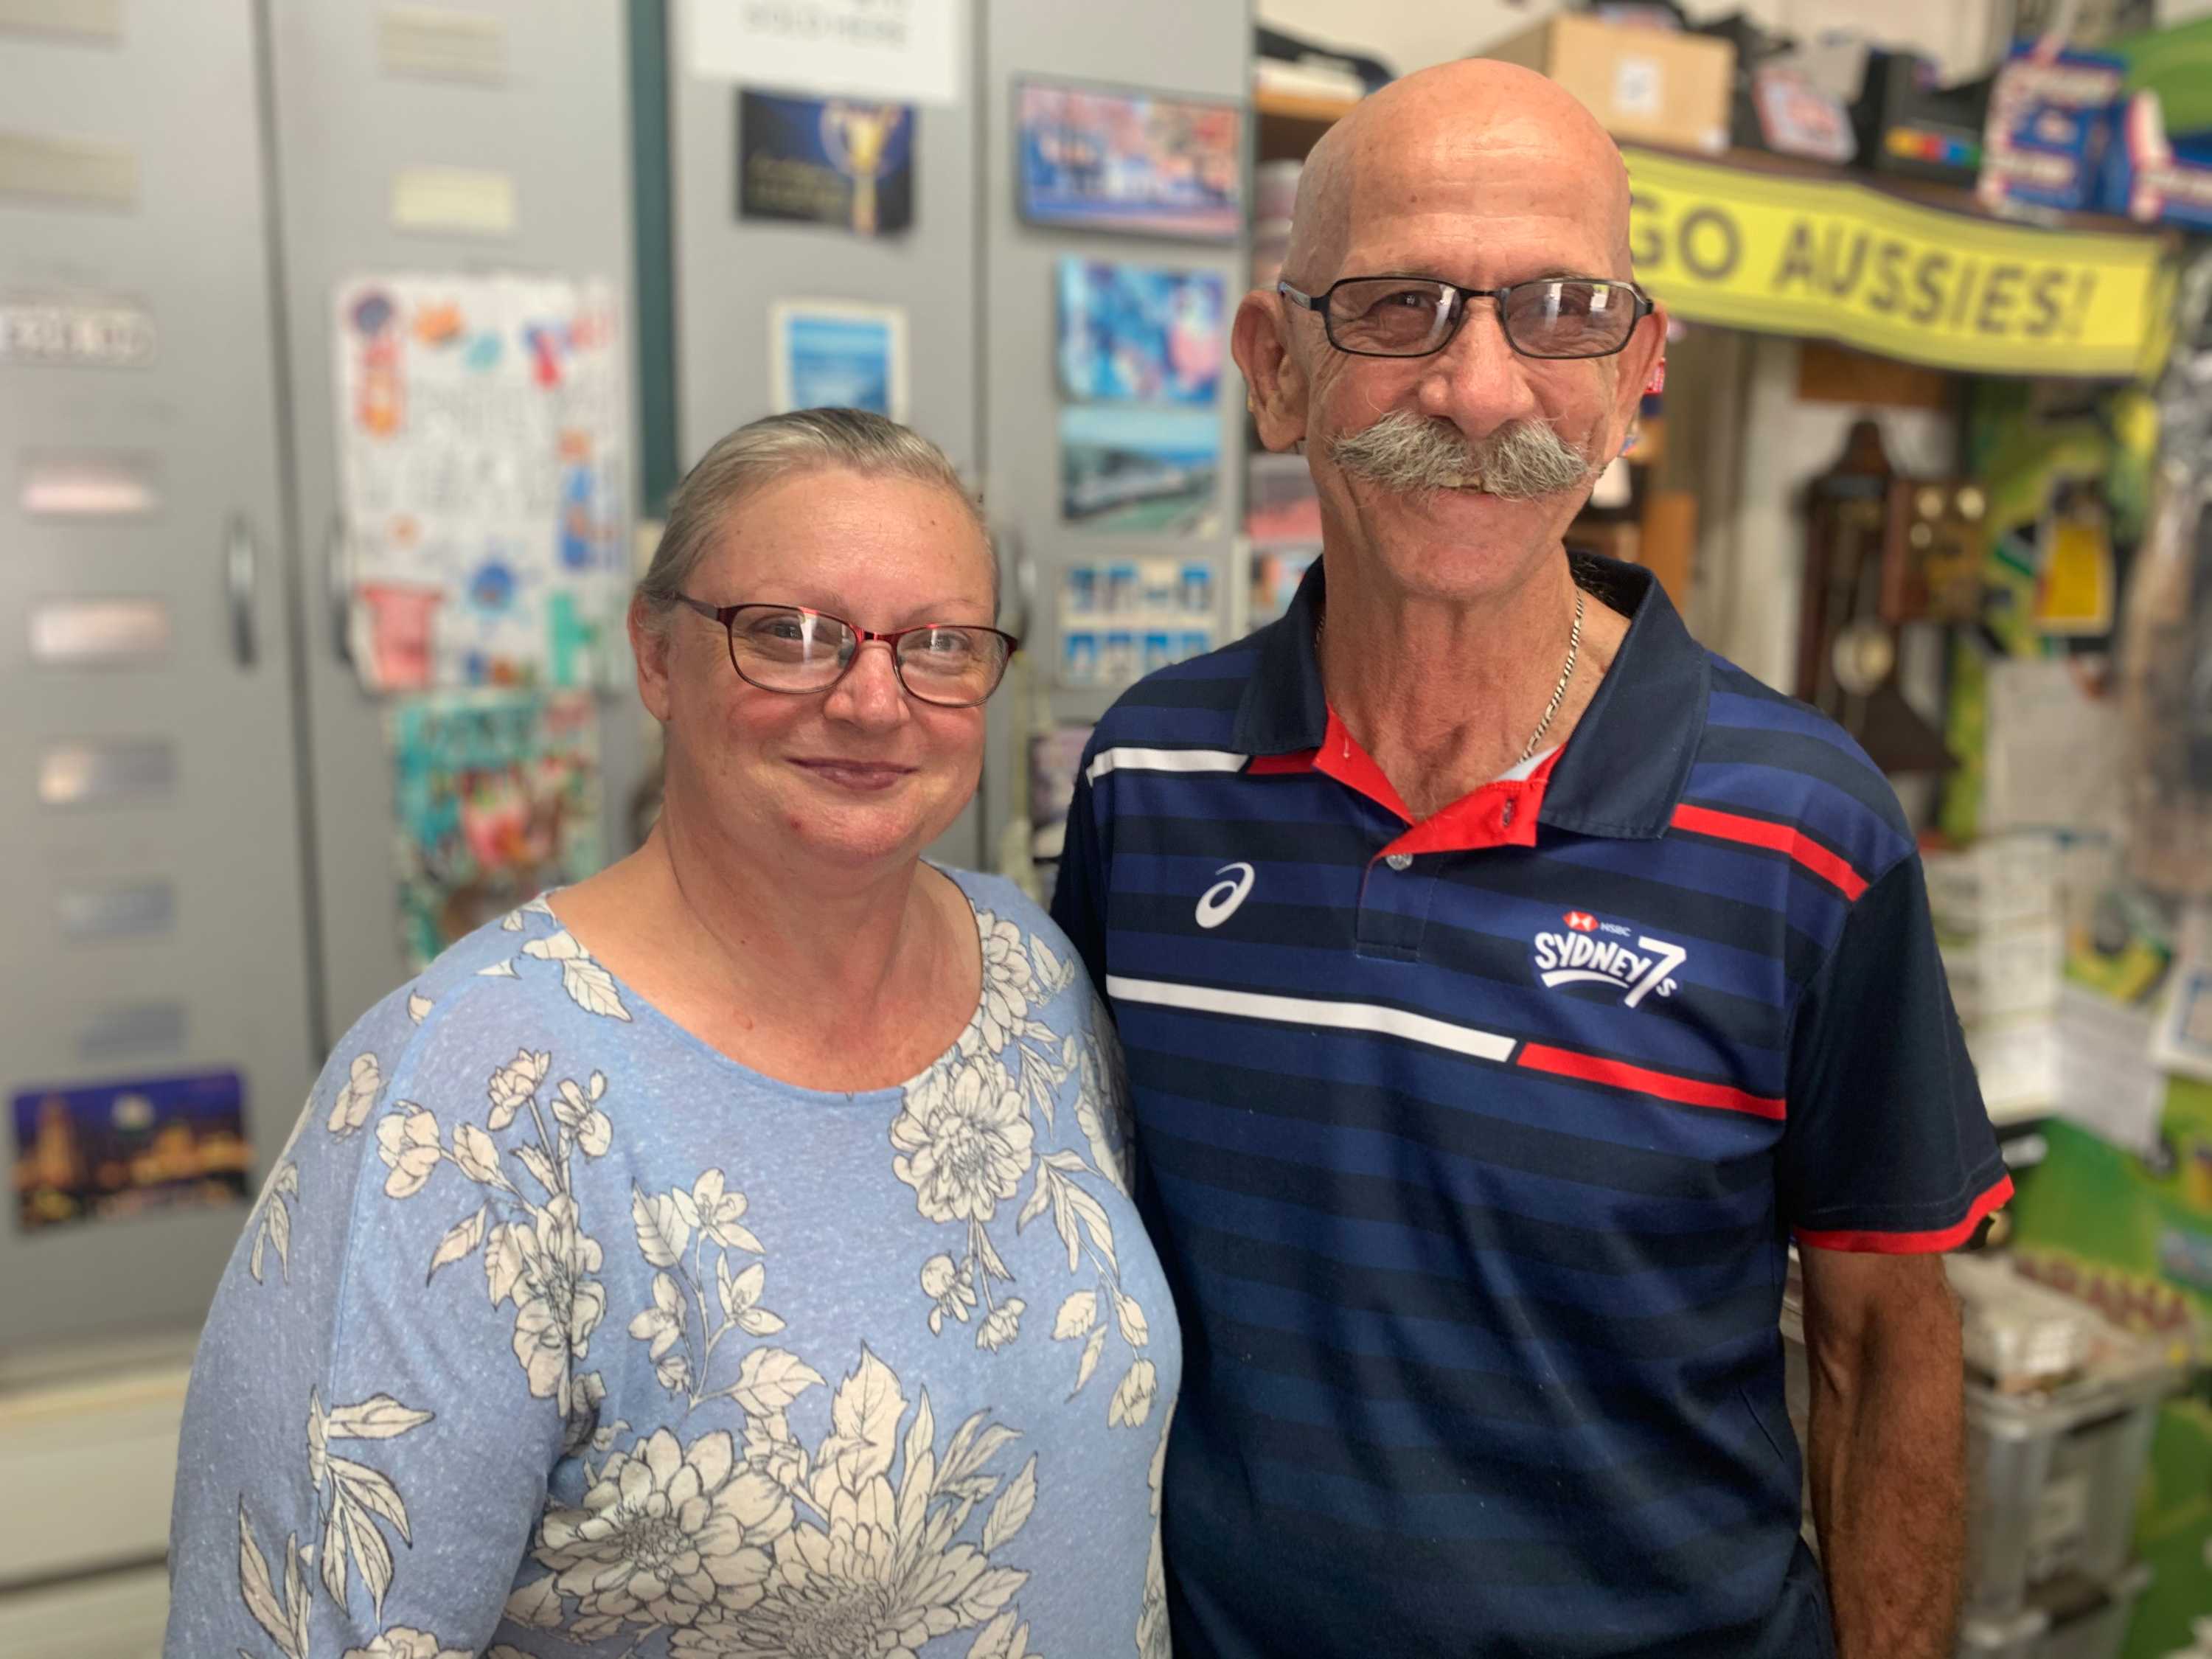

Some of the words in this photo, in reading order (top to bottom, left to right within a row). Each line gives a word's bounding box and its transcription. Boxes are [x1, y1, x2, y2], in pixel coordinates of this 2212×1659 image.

[1771, 220, 2098, 341] AUSSIES!
[1600, 922, 1631, 937] HSBC
[1534, 931, 1652, 983] SYDNEY
